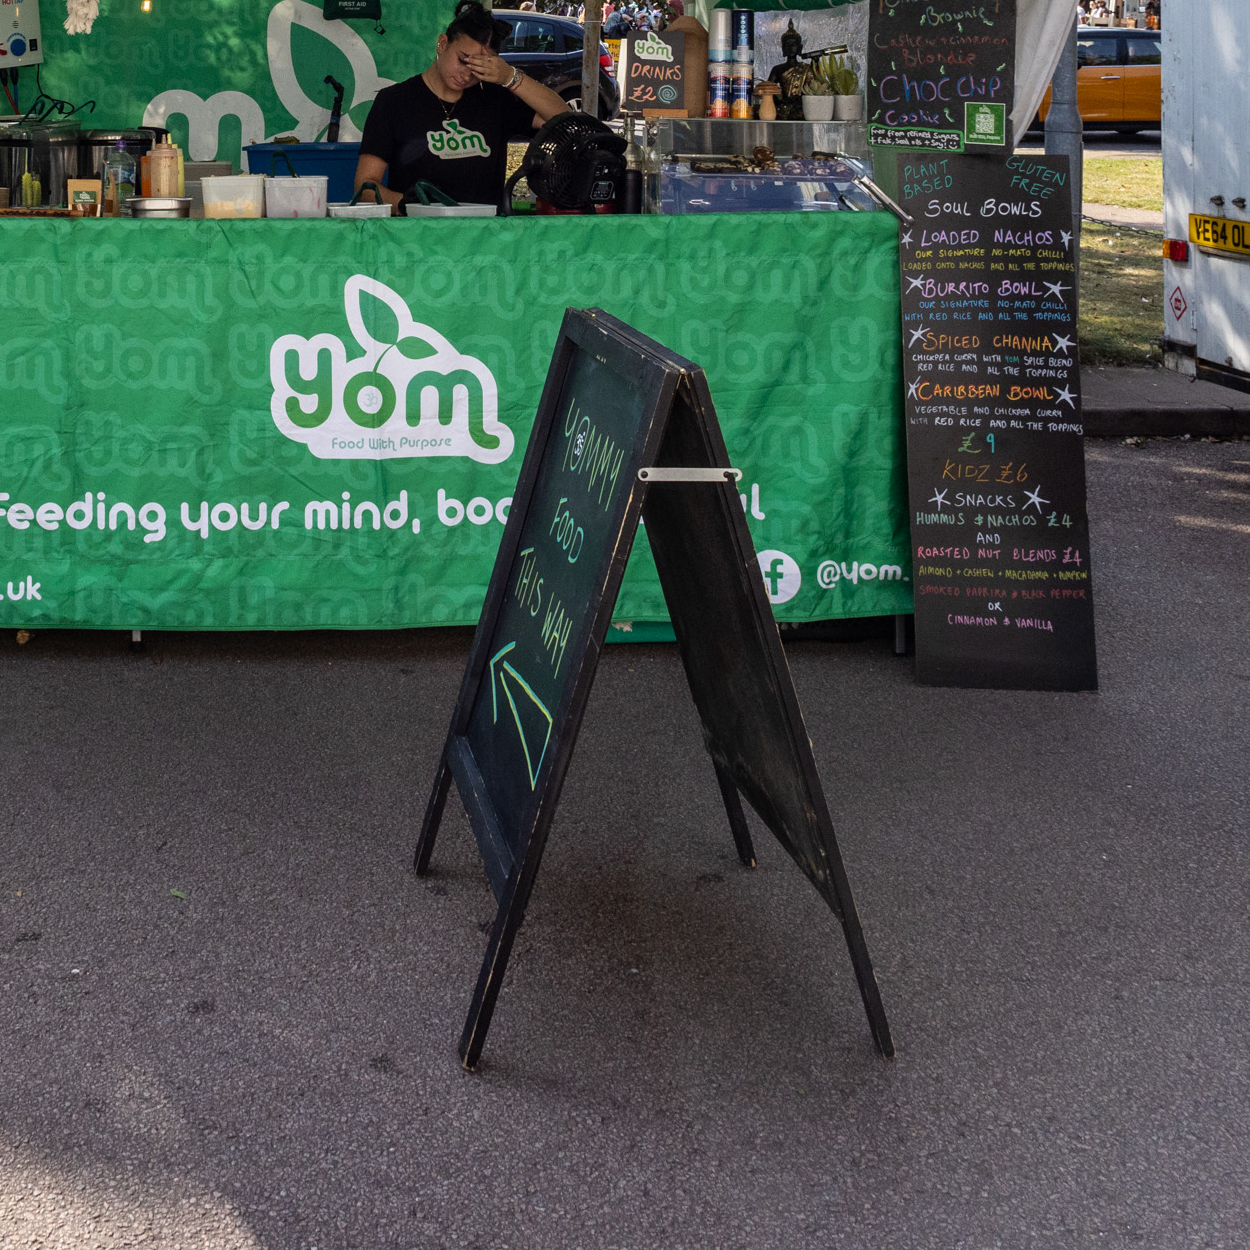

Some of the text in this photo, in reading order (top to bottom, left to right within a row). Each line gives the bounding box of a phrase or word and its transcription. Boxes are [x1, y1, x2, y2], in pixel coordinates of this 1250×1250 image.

[637, 41, 671, 59] yom
[631, 63, 681, 80] DRINKS
[629, 85, 656, 102] £2
[431, 133, 488, 153] yom
[904, 159, 949, 182] PLANT
[1005, 155, 1066, 186] GLUTEN
[903, 175, 953, 200] BASED
[1010, 176, 1054, 199] FREE
[924, 198, 1042, 218] SOUL BOWLS
[921, 229, 1053, 247] LOADED NACHOS
[1195, 218, 1227, 245] VE64
[922, 278, 1042, 298] BURRITO BOWL
[922, 332, 1053, 353] SPICED CHANNA
[283, 345, 501, 450] yom
[918, 382, 1053, 401] CARIBBEAN BOWL
[331, 437, 452, 451] Food With Purpose
[942, 459, 1028, 484] KIDZ £6
[954, 493, 1016, 507] SNACKS
[180, 501, 290, 539] your
[304, 490, 421, 534] mind,
[437, 488, 514, 527] bo
[916, 512, 965, 525] HUMMUS
[987, 514, 1037, 528] NACHOS
[1046, 511, 1073, 527] £4
[549, 498, 584, 563] FOOD
[917, 546, 1082, 566] ROASTED NUT BLENDS £4
[817, 560, 909, 589] @yom.
[515, 547, 573, 679] THIS WAY
[947, 614, 997, 626] CINNAMON
[1015, 618, 1053, 632] VANILLA
